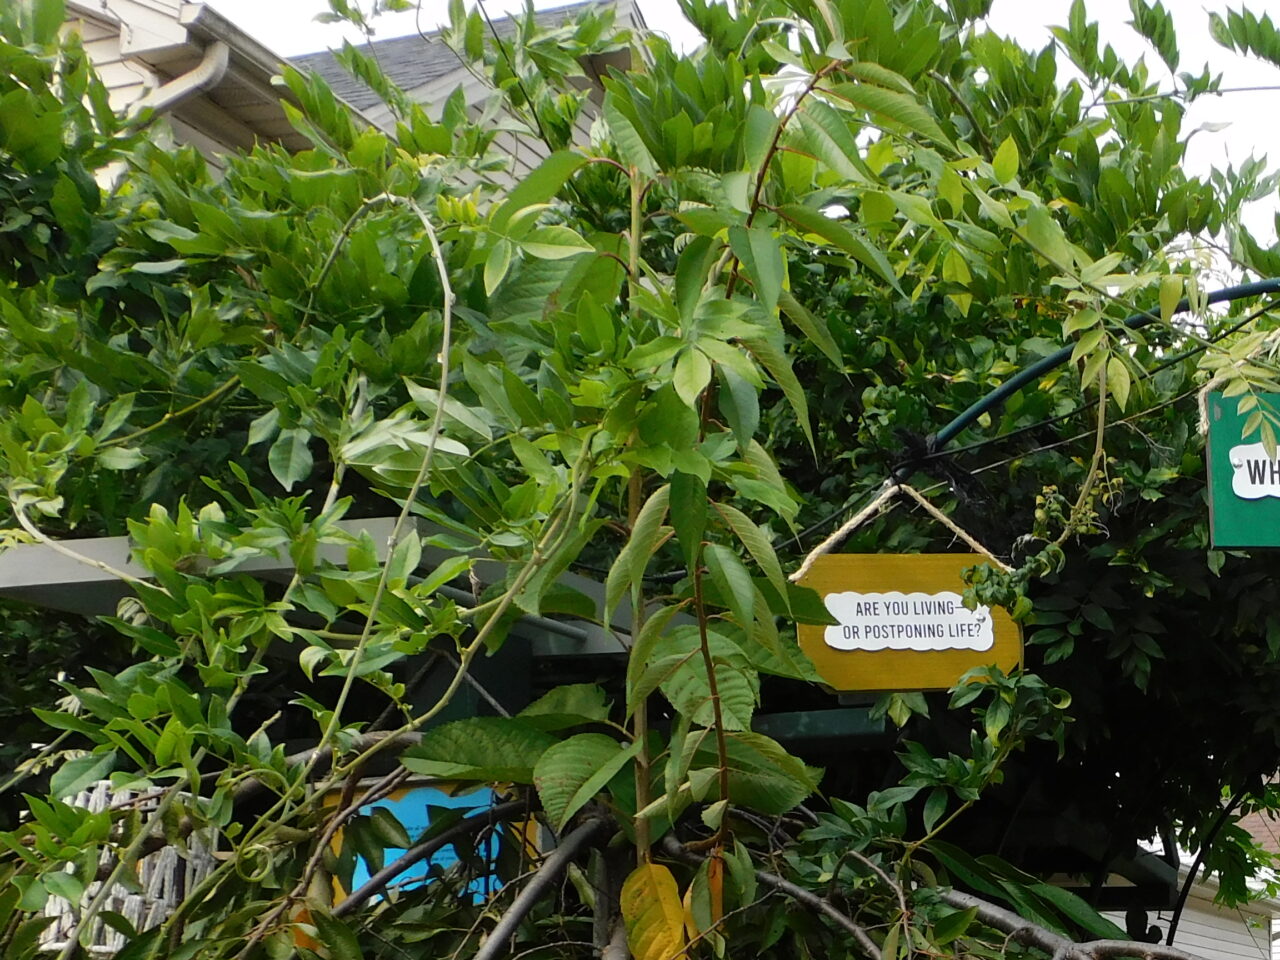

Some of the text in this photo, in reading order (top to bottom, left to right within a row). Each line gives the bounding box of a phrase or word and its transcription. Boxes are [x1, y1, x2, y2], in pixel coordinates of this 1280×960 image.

[856, 602, 880, 617] ARE
[884, 601, 909, 616] YOU
[843, 623, 982, 640] OR POSTPONING LIFE?
